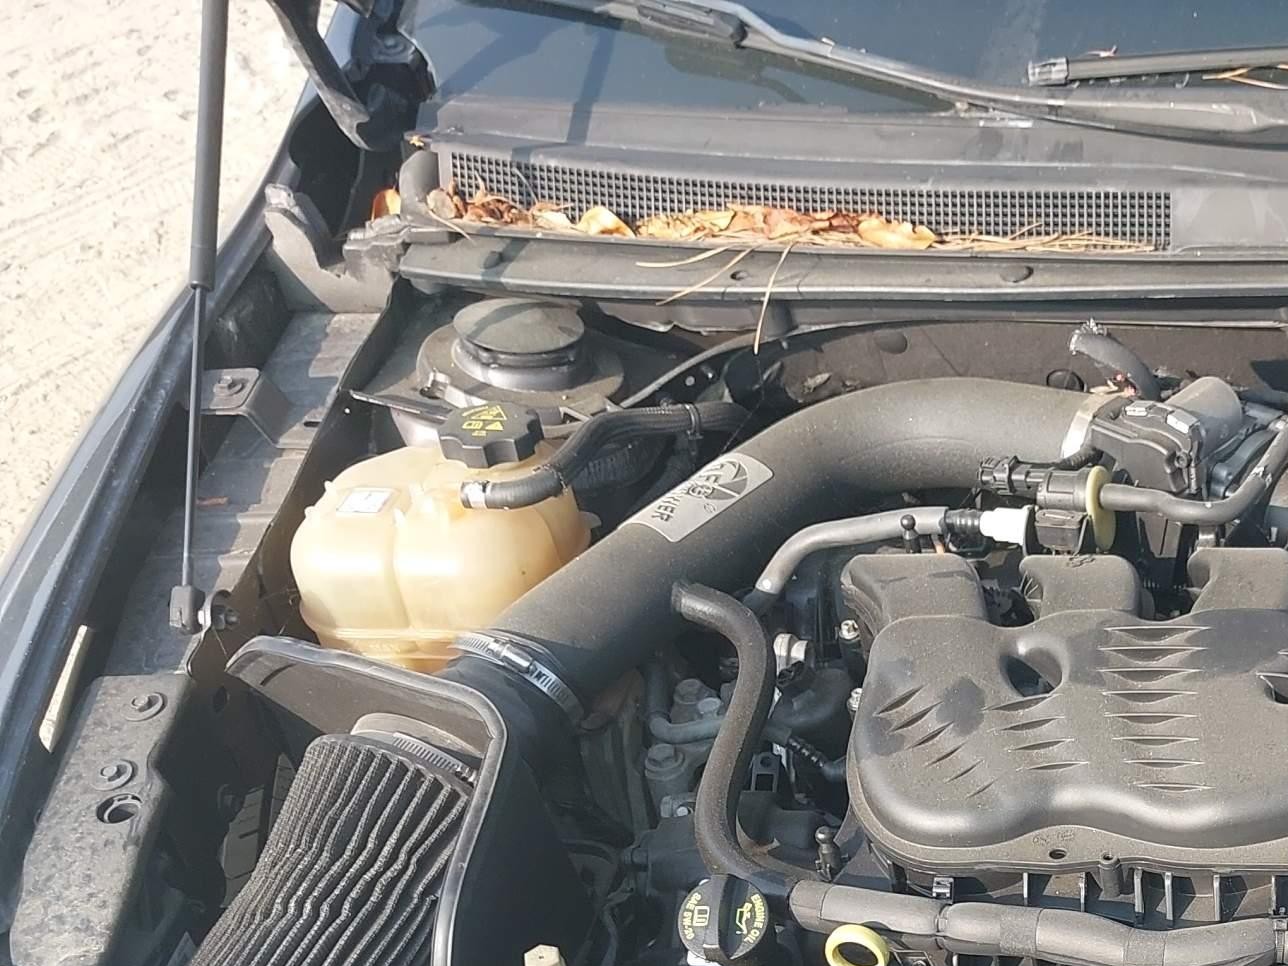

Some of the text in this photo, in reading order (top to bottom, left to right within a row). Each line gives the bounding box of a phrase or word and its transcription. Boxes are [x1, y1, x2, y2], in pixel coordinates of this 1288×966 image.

[686, 892, 702, 911] SAE
[744, 893, 765, 943] ENGINE OIL
